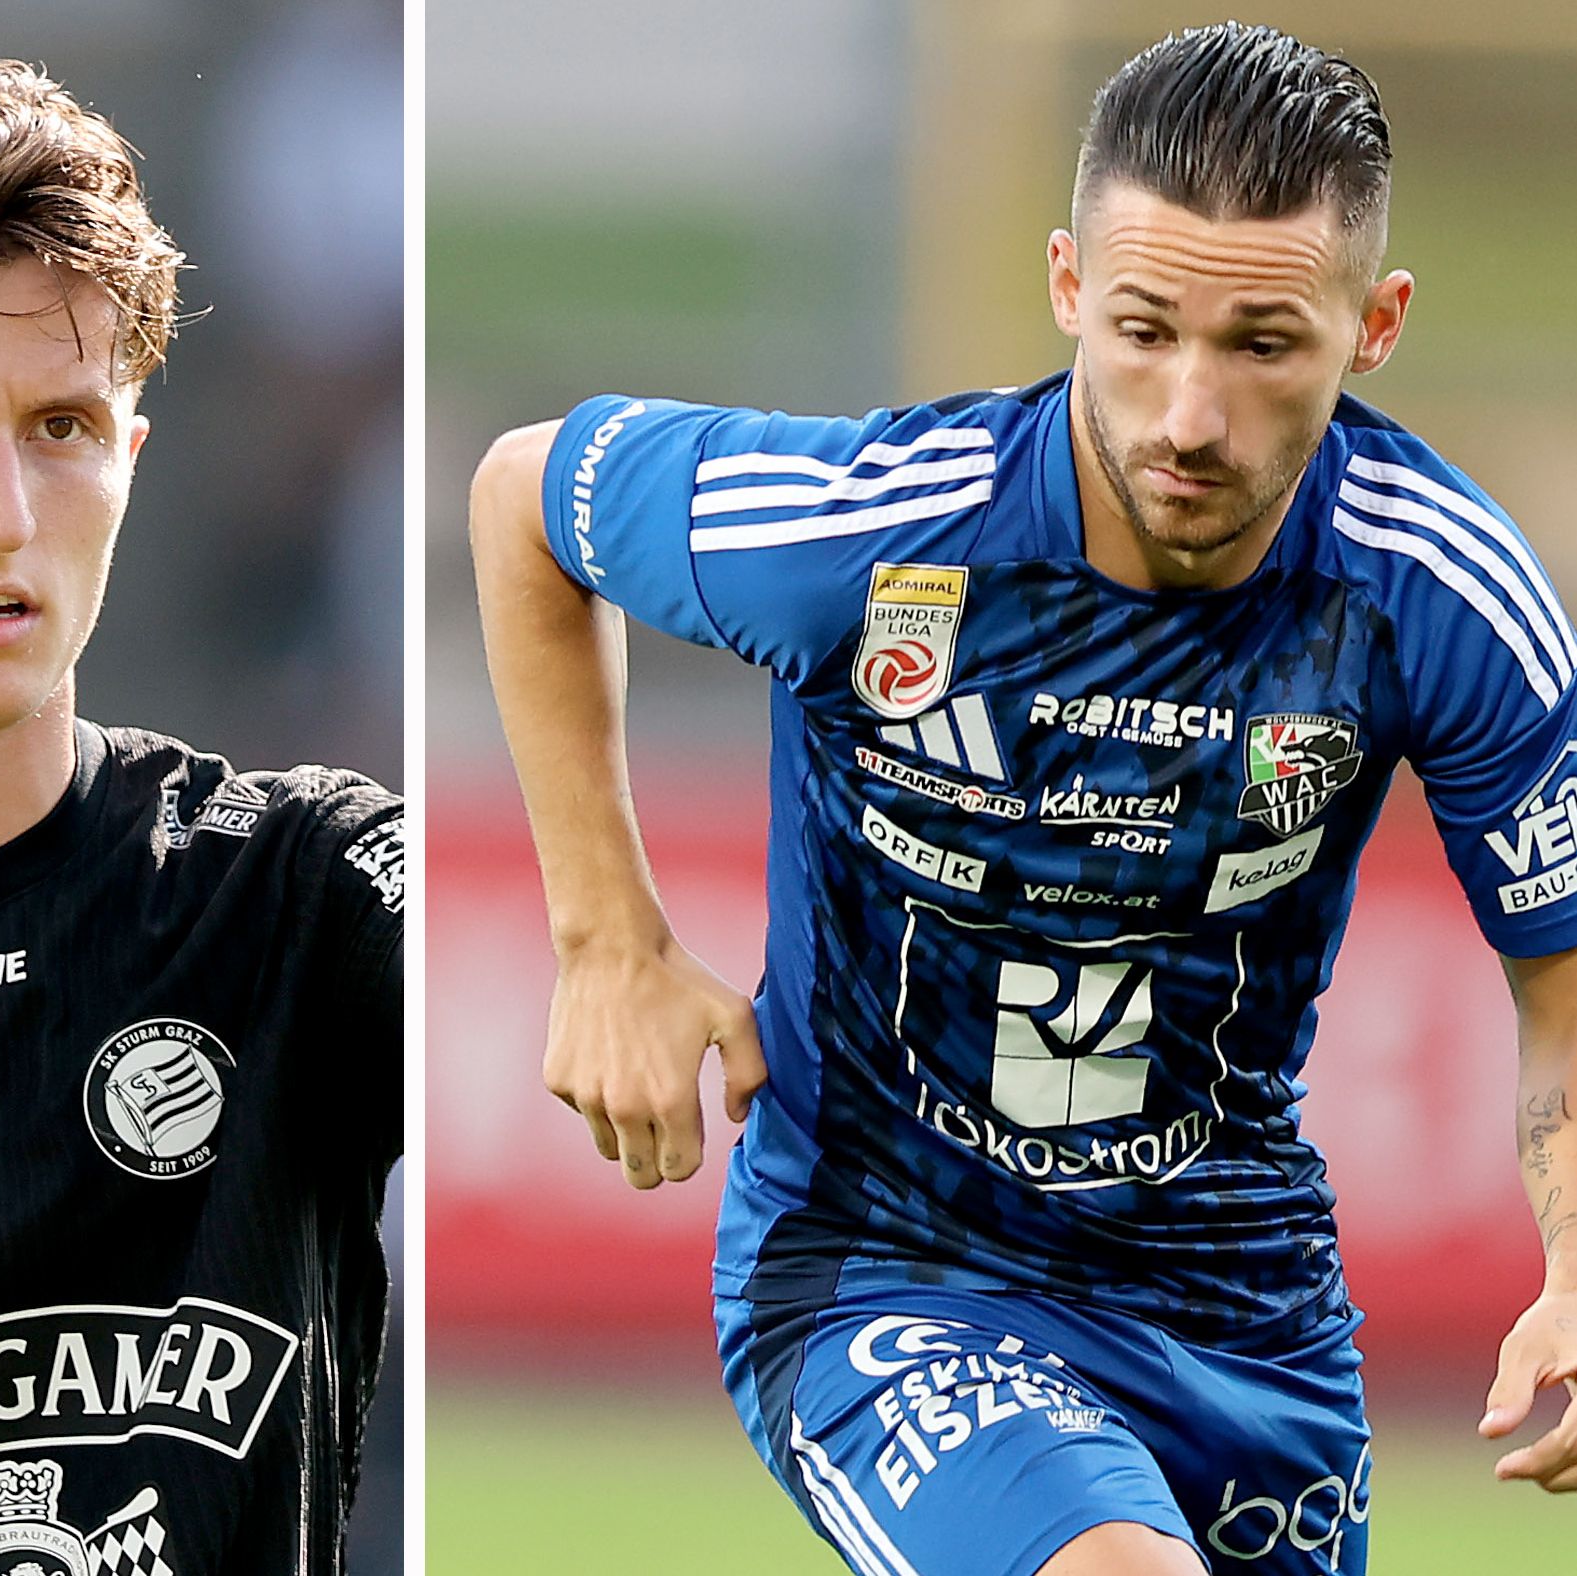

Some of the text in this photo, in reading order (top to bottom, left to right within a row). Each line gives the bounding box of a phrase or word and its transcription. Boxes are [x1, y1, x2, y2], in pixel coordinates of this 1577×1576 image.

[574, 401, 646, 585] ADMIRAL
[877, 578, 958, 595] ADMIRAL
[874, 607, 954, 624] BUNDES
[888, 622, 932, 637] LIGA
[1029, 692, 1234, 741] ROBITSCH
[1039, 774, 1181, 819] KÄRNTEN
[1262, 765, 1338, 807] WAC
[869, 821, 977, 883] ORF K
[1091, 830, 1172, 855] SPORT
[1229, 848, 1309, 891] kelag
[1510, 865, 1577, 908] BAU-
[1024, 883, 1161, 909] velox.at
[100, 1025, 204, 1070] SK STURM GRAZ
[149, 1146, 211, 1174] SEIT 1909
